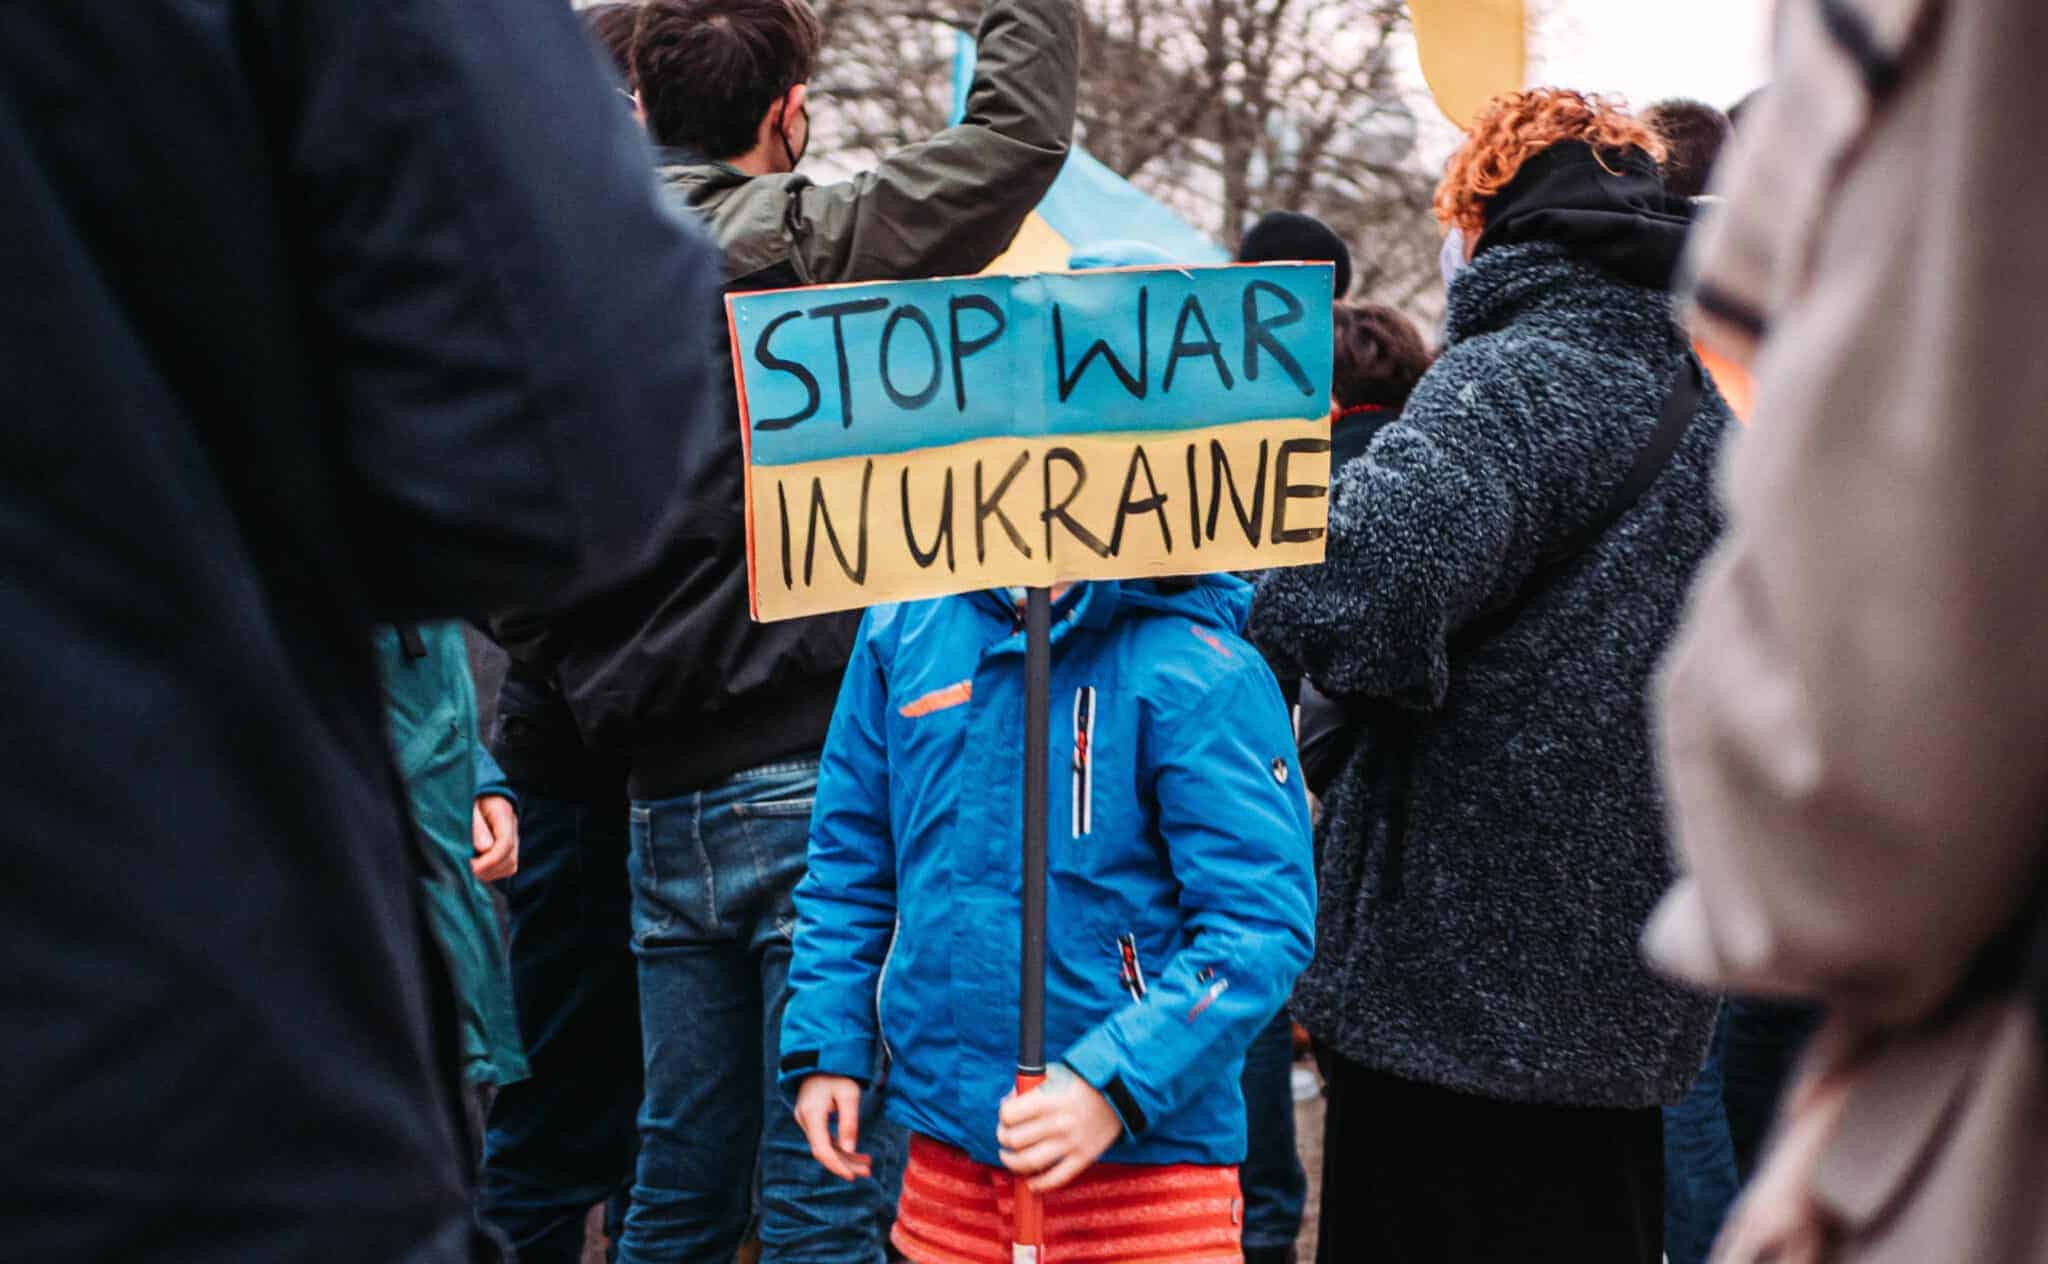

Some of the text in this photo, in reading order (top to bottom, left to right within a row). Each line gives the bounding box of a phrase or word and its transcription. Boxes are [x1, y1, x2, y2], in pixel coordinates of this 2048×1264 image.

[753, 279, 1316, 432] STOP WAR
[777, 438, 1331, 591] IN UKRAINE
